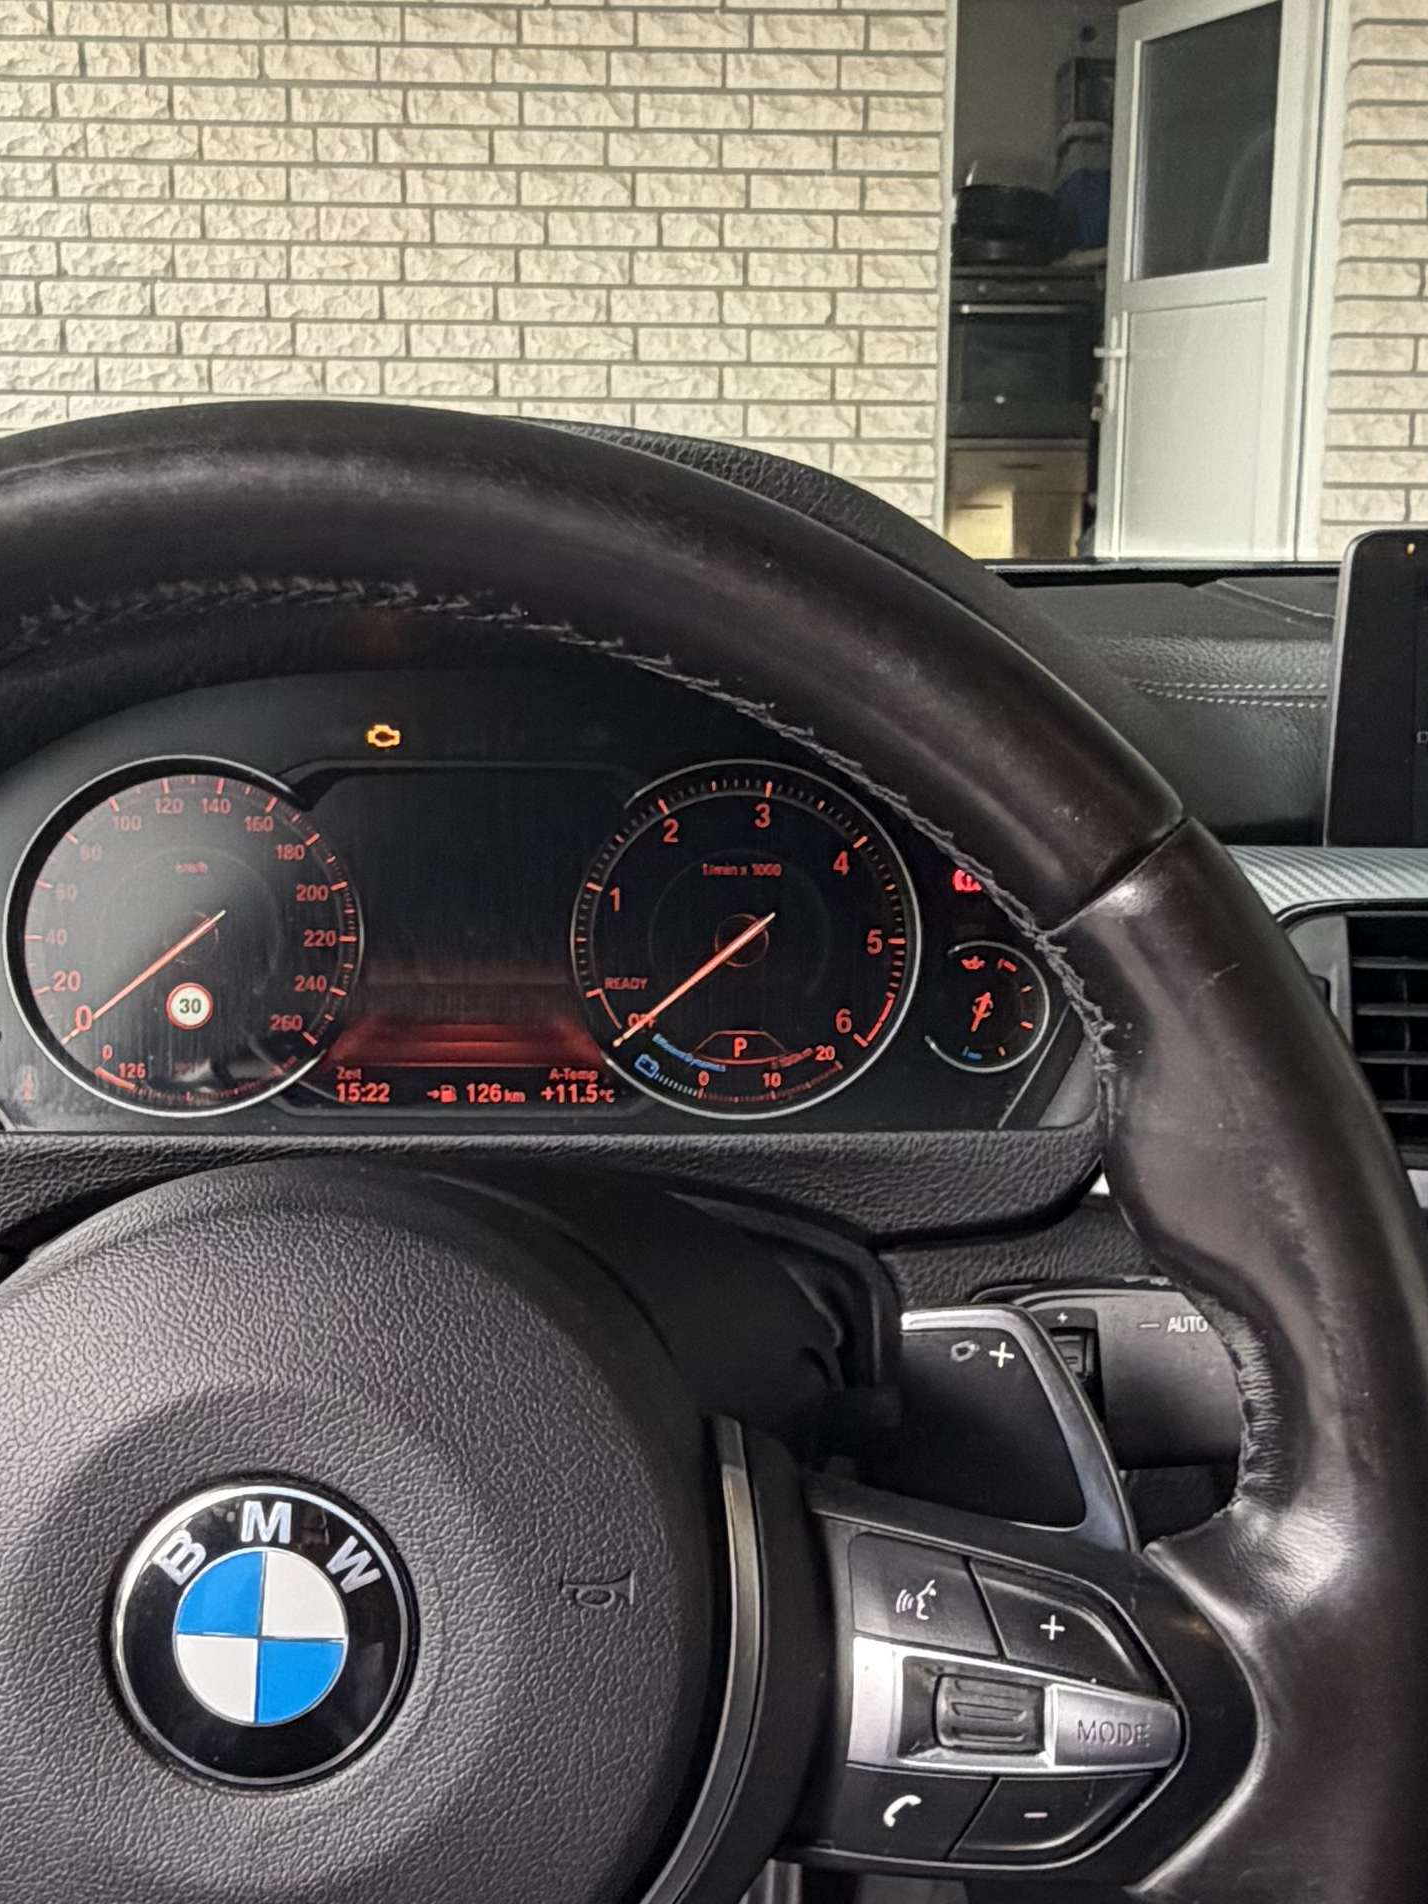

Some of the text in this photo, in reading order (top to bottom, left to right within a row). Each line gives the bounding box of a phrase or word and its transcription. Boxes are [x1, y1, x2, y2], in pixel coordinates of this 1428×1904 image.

[155, 799, 184, 814] 120
[202, 799, 231, 814] 140
[112, 816, 141, 831] 100
[755, 803, 771, 828] 3
[663, 818, 679, 843] 2
[276, 845, 305, 860] 180
[833, 851, 850, 876] 4
[296, 885, 328, 902] 200
[609, 887, 621, 912] 1
[45, 930, 68, 946] 40
[304, 930, 336, 947] 220
[866, 929, 883, 954] 5
[53, 971, 82, 992] 20
[294, 976, 327, 992] 240
[604, 977, 649, 991] READY
[179, 998, 202, 1014] 30
[75, 1005, 93, 1032] 0
[270, 1015, 303, 1032] 260
[835, 1008, 852, 1034] 6
[102, 1045, 113, 1060] 0
[733, 1037, 748, 1057] P
[815, 1046, 836, 1061] 20
[118, 1063, 146, 1079] 126
[336, 1067, 362, 1080] Zeit
[549, 1068, 598, 1082] A-Temp
[698, 1071, 710, 1086] 0
[763, 1072, 782, 1087] 10
[336, 1082, 390, 1104] 15:22
[466, 1083, 526, 1103] 126 km
[1167, 1315, 1209, 1334] AUTO
[151, 1501, 381, 1594] BMW
[1077, 1720, 1152, 1748] MODE
